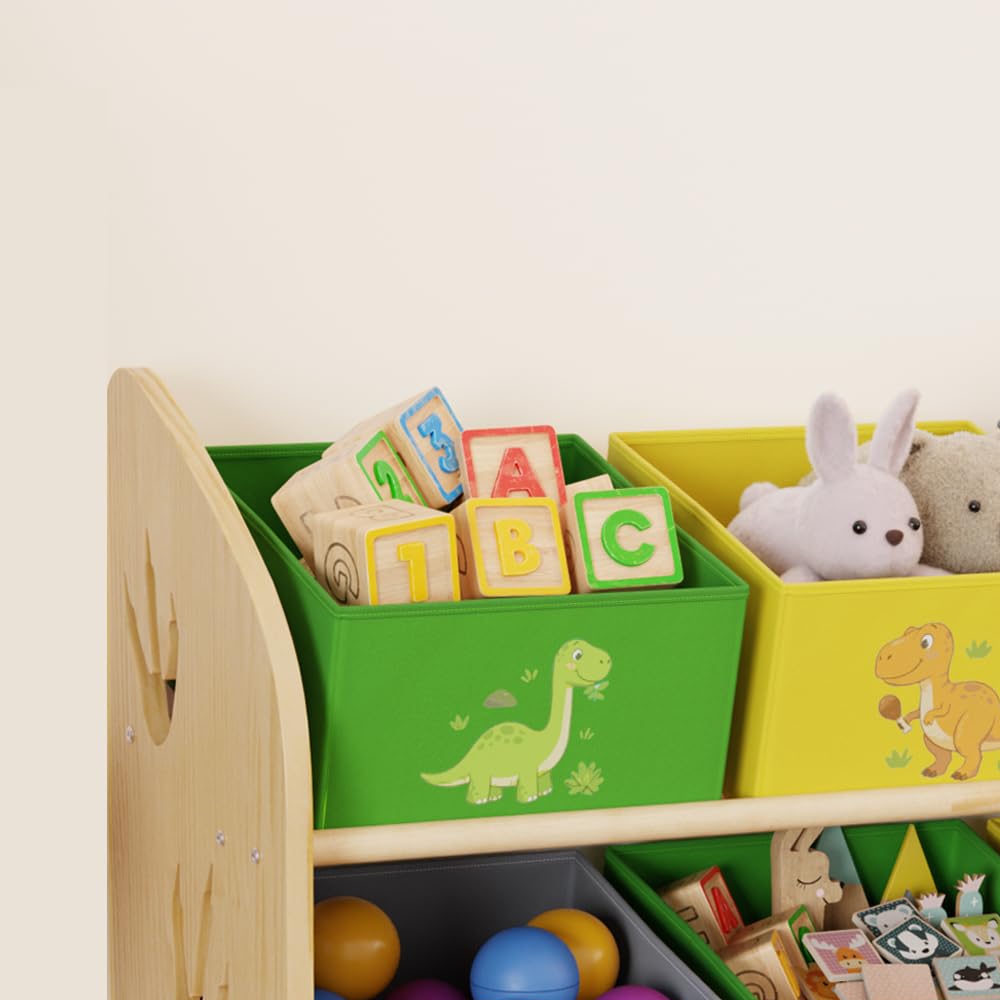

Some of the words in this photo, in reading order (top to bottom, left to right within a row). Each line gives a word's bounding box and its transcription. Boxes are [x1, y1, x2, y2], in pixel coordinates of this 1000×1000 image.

[416, 412, 459, 473] 3
[373, 460, 416, 503] 2
[490, 447, 547, 498] A
[493, 517, 541, 577] B
[601, 509, 655, 567] C
[397, 542, 429, 603] 1
[710, 886, 739, 934] A
